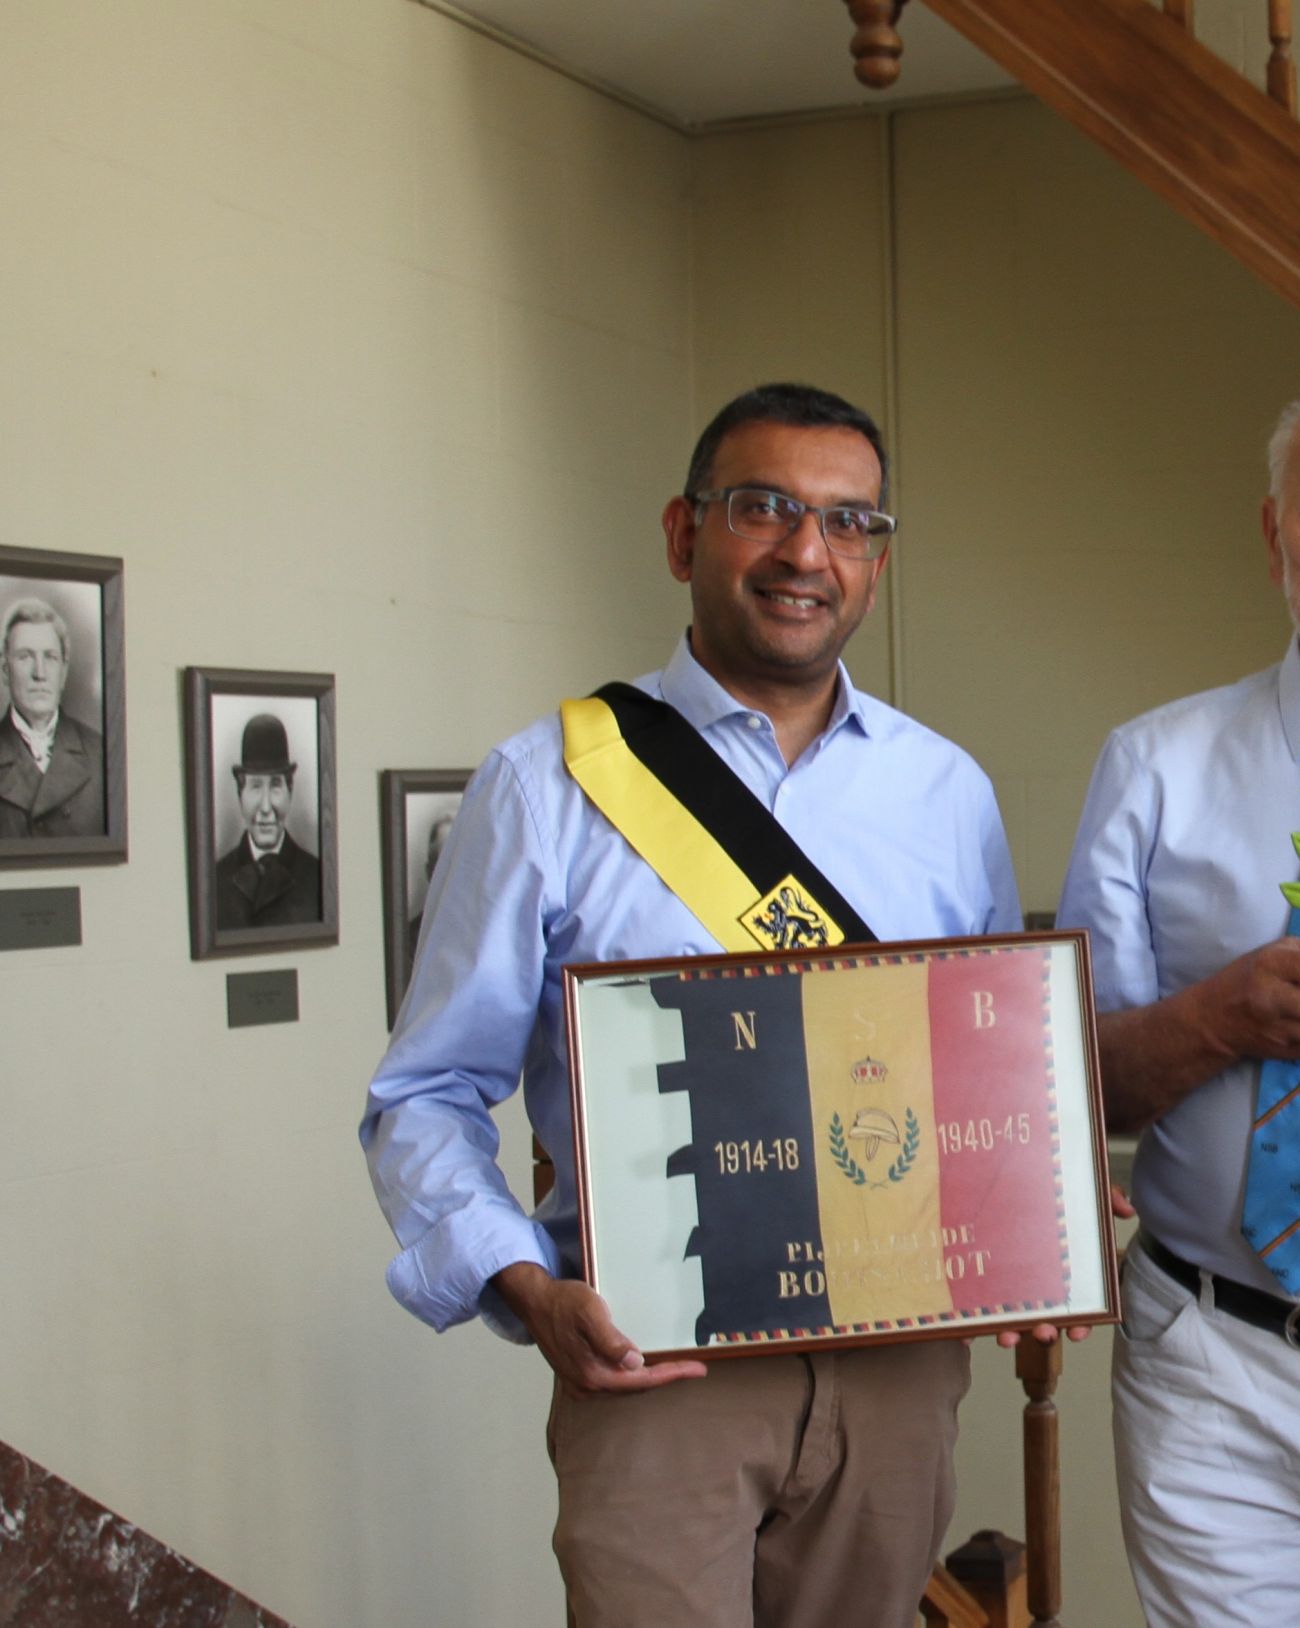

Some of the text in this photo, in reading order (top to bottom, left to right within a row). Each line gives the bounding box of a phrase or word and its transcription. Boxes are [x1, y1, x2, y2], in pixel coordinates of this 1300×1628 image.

[731, 990, 996, 1051] N S B
[714, 1113, 1031, 1175] 1914-18 1940-45
